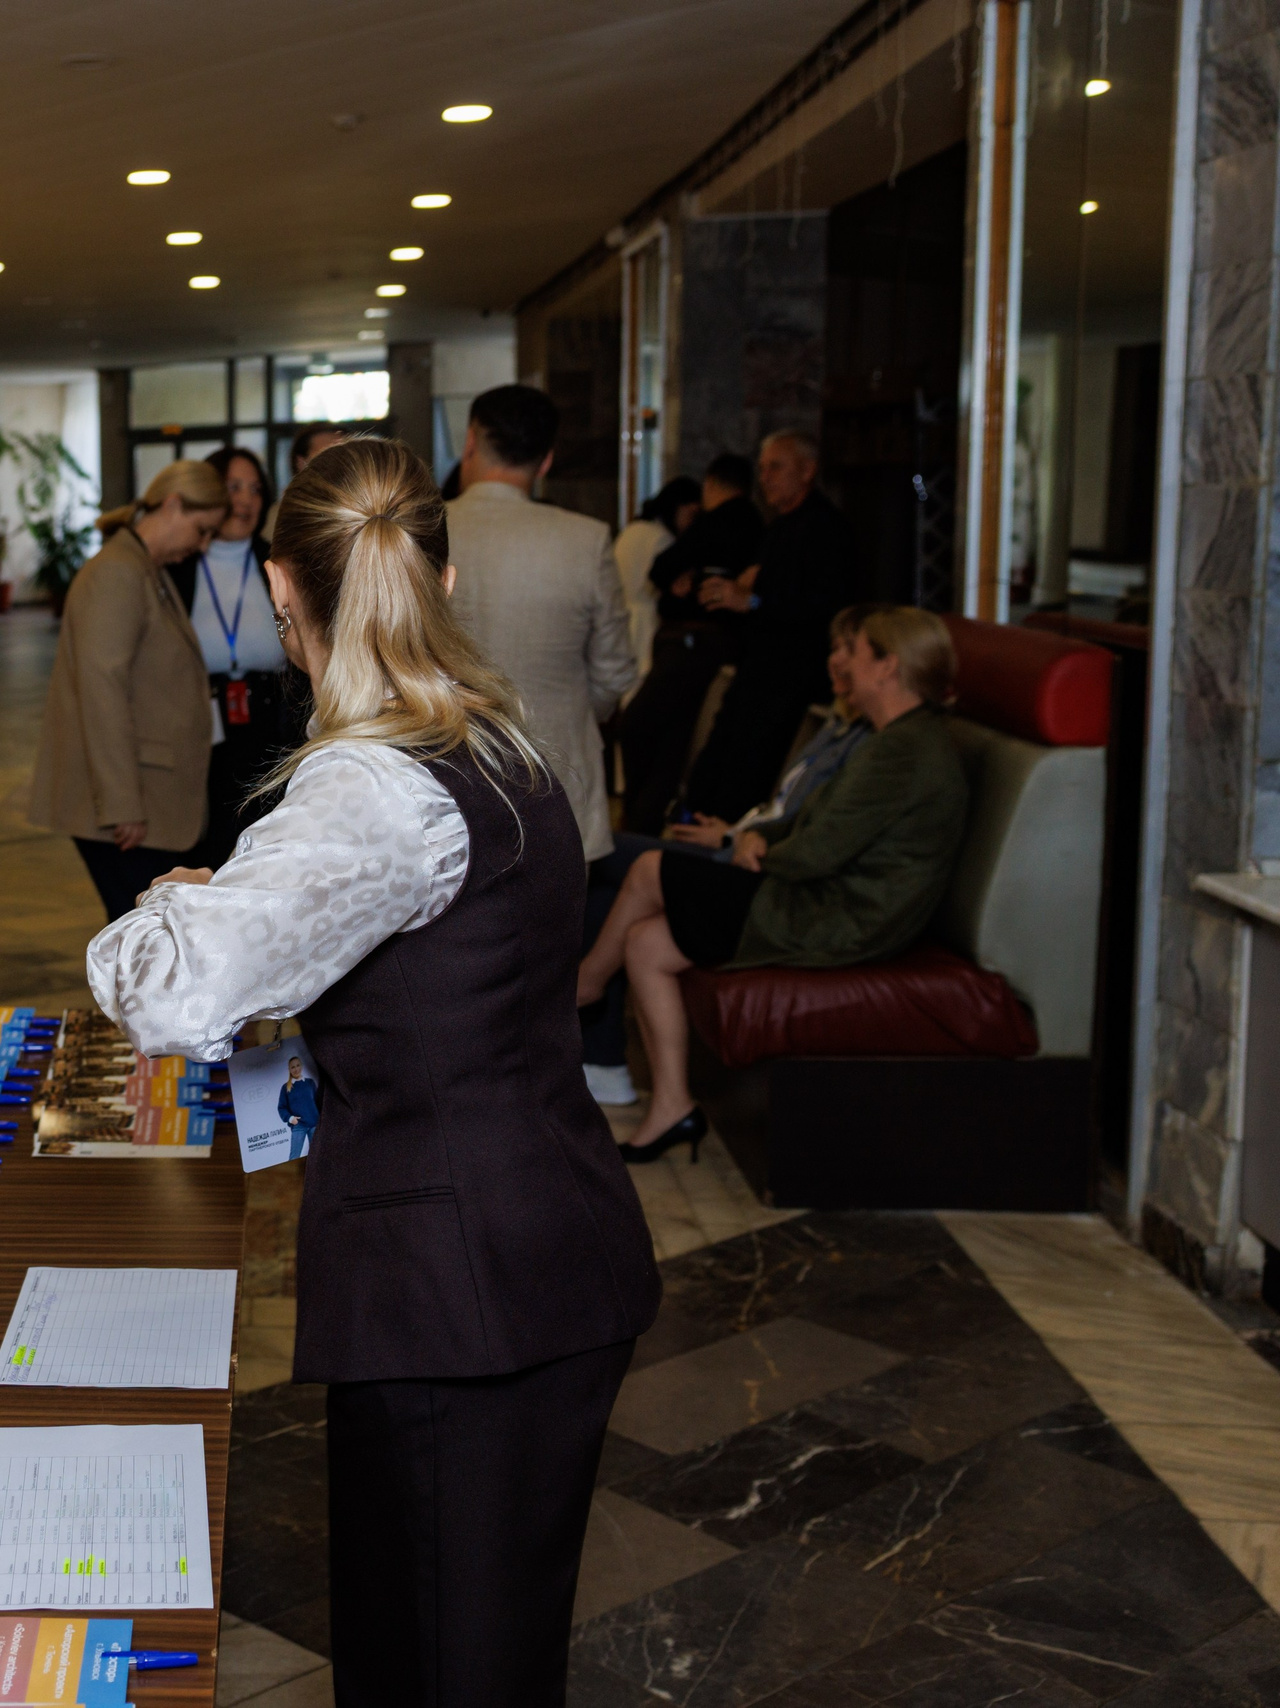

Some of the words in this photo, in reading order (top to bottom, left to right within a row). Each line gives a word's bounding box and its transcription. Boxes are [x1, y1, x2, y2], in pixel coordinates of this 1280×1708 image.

[247, 1132, 269, 1143] НАДЕЖДА
[9, 1623, 25, 1656] «Soloviev
[59, 1624, 75, 1666] «Авторский
[1, 1656, 16, 1694] architects»
[105, 1642, 121, 1682] «Пстор»
